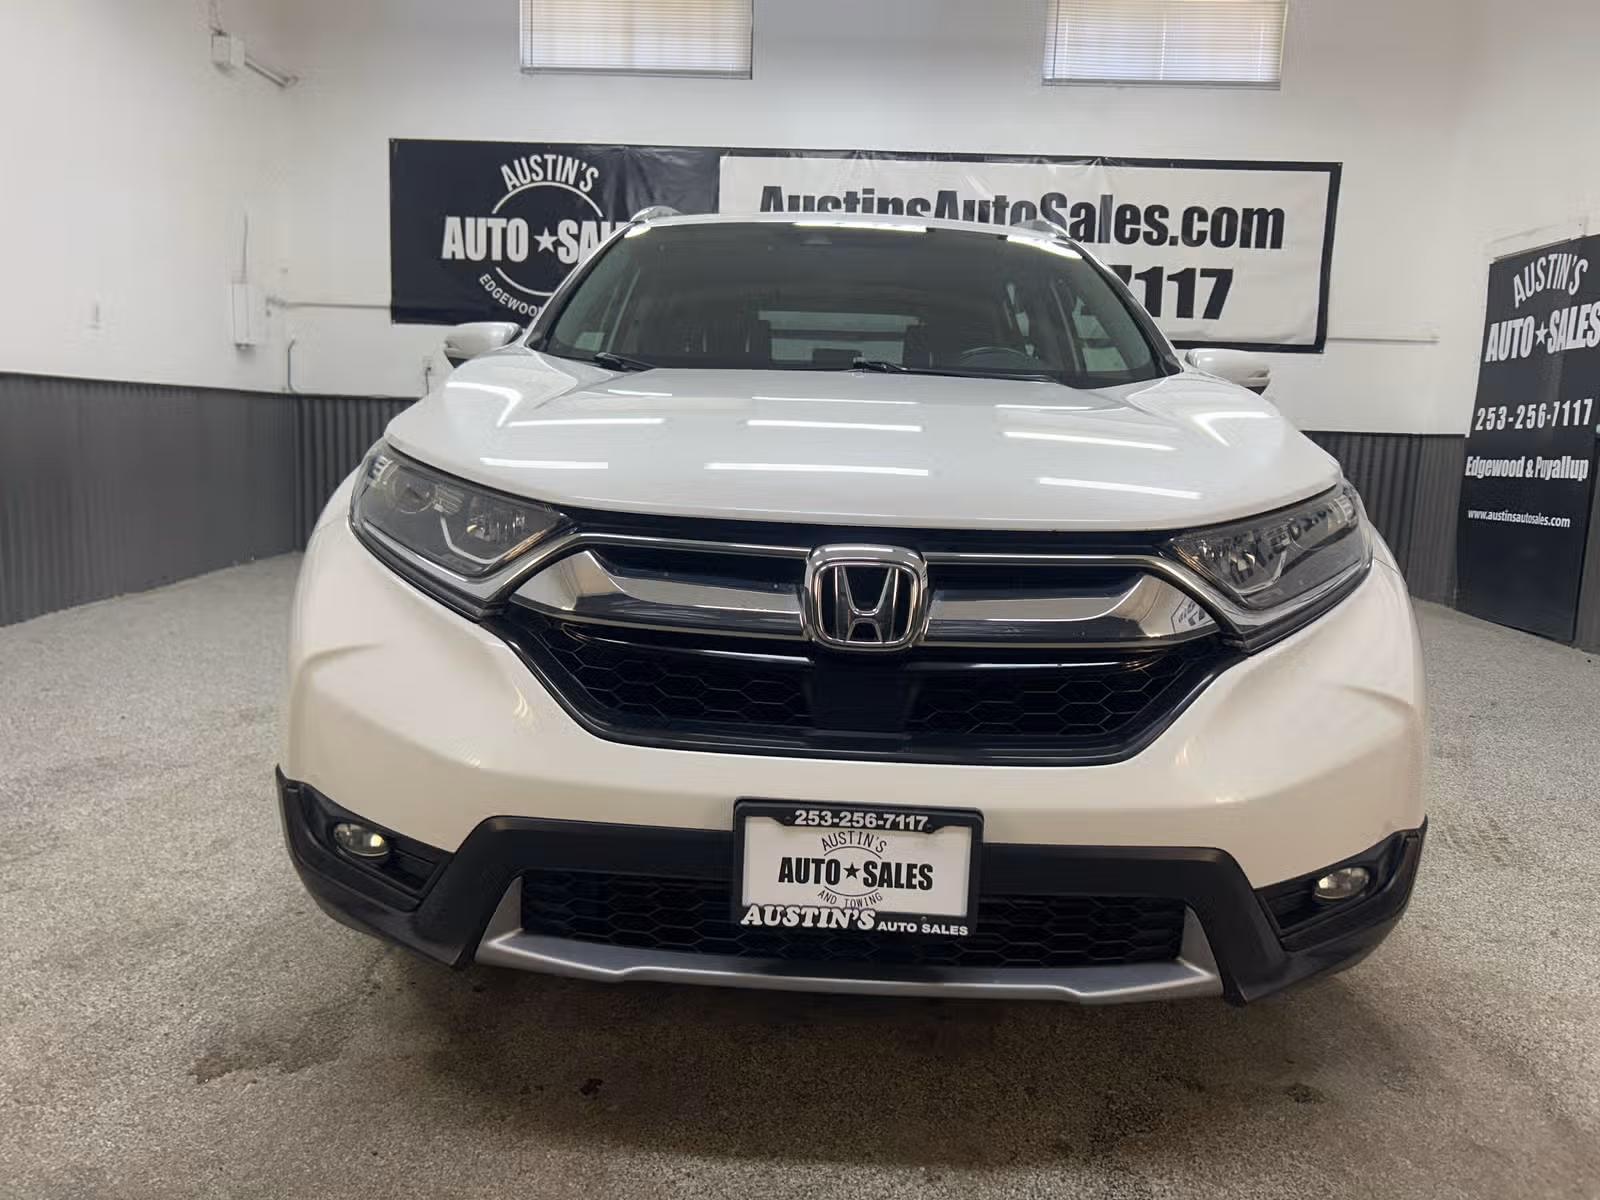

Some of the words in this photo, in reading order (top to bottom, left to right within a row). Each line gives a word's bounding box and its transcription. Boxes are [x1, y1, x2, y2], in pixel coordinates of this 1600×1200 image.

[500, 153, 599, 193] AUSTIN'S
[441, 216, 529, 262] AUTO
[478, 273, 544, 319] EDGEWOO
[1513, 253, 1588, 309] AUSTIN'S
[1485, 315, 1535, 362] AUTO
[1547, 300, 1600, 353] SALES
[1475, 398, 1593, 431] 253-256-7117
[1465, 456, 1525, 479] Edgewood
[1526, 459, 1534, 478] &
[1534, 456, 1589, 482] Puyallup
[1468, 509, 1571, 528] www.austinsautosales.com
[794, 809, 928, 832] 253-256-7117
[821, 830, 887, 854] AUSTIN'S
[778, 857, 841, 885] AUTO
[862, 861, 934, 891] SALES
[817, 889, 838, 905] AND
[740, 903, 876, 931] AUSTIN'S
[877, 922, 918, 933] AUTO
[921, 923, 969, 936] SALES
